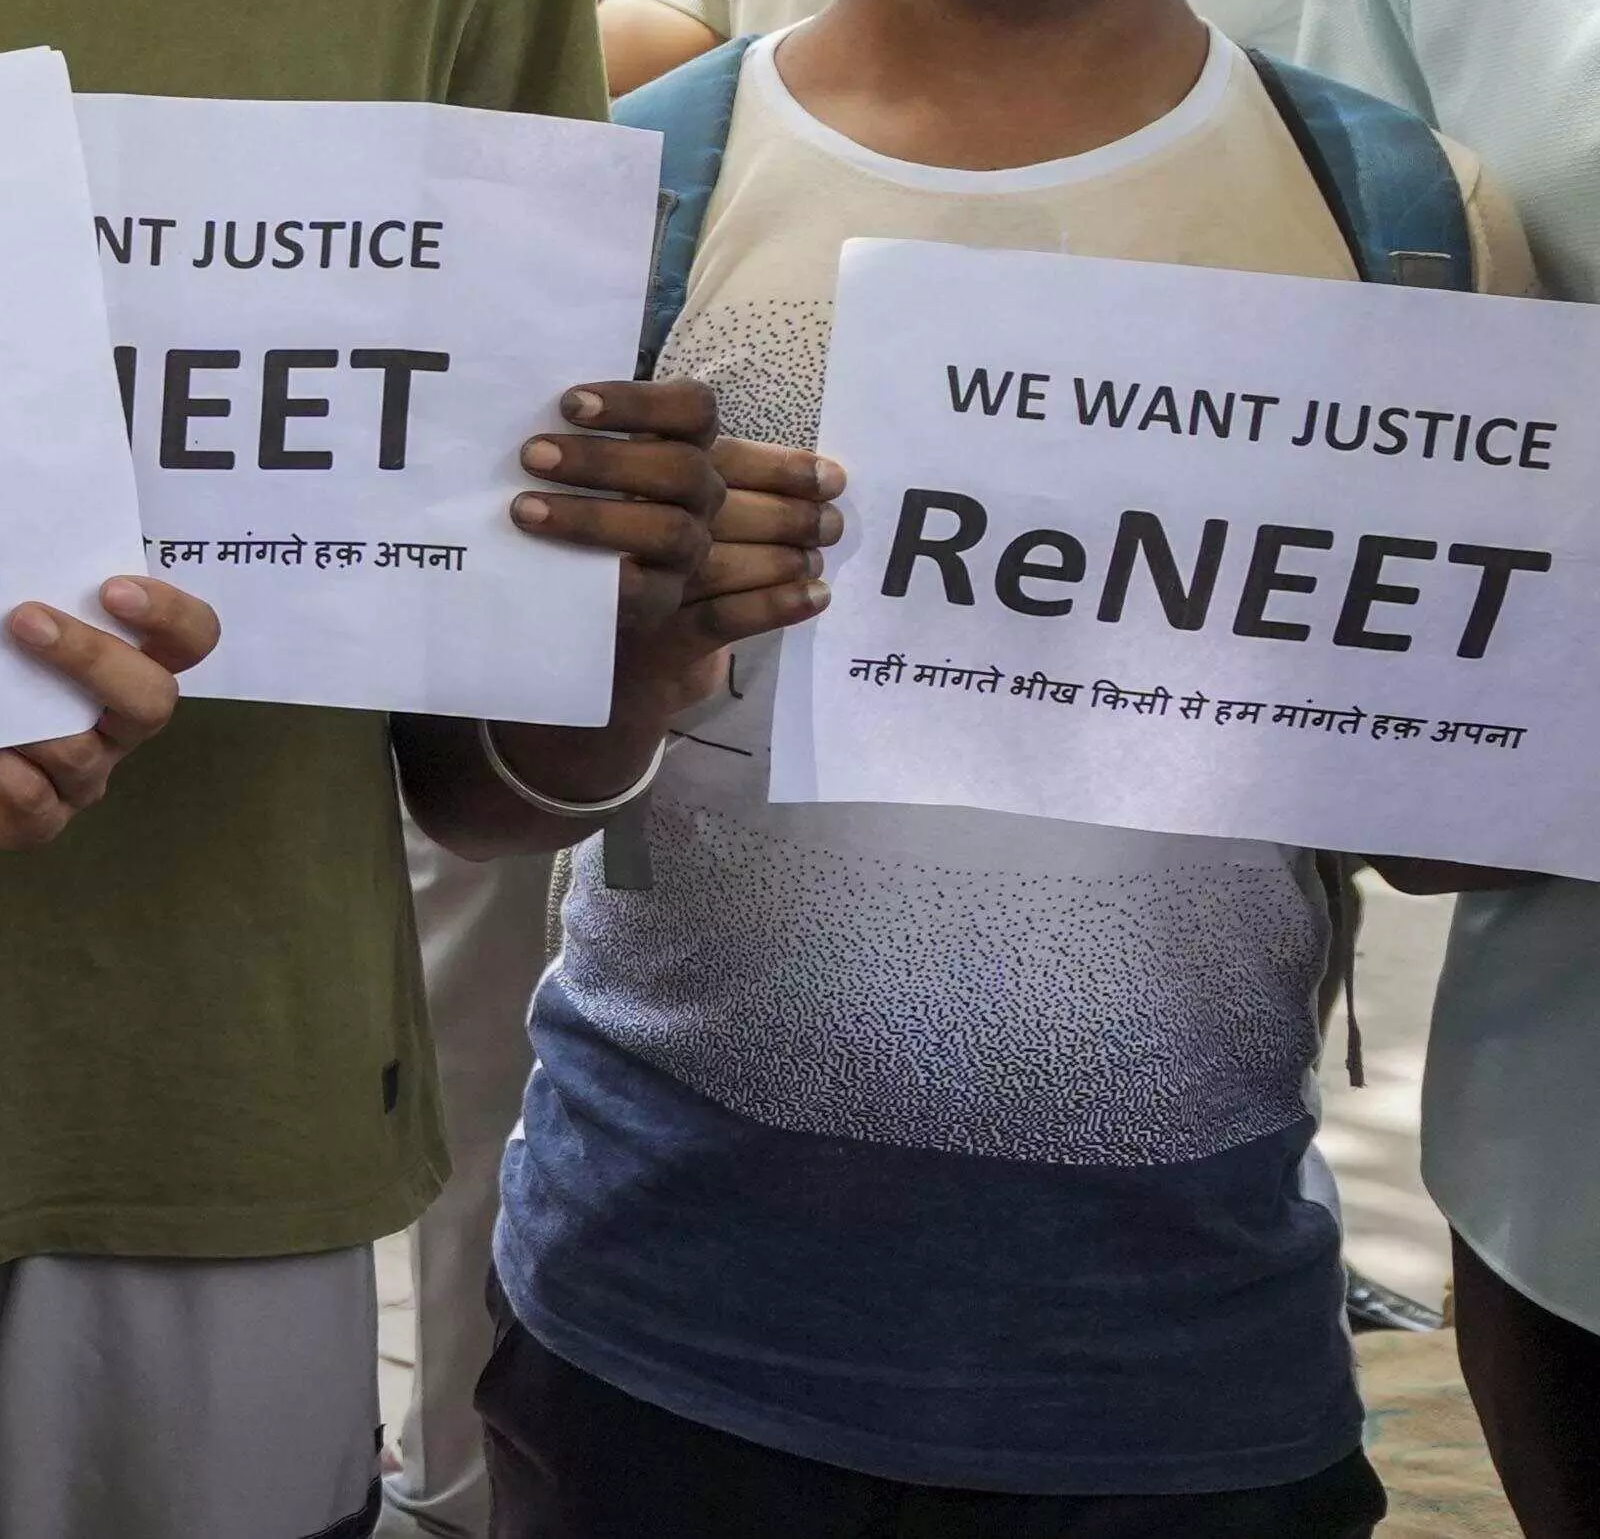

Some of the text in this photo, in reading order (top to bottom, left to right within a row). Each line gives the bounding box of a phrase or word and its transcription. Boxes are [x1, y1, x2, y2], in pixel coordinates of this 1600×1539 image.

[96, 215, 443, 269] NT JUSTICE
[113, 346, 450, 471] EET
[946, 364, 1557, 470] WE WANT JUSTICE
[159, 540, 209, 568] हम
[216, 533, 307, 565] मांगते
[373, 541, 467, 571] अपना
[880, 487, 1553, 660] ReNEET
[848, 653, 907, 686] नहीं
[912, 658, 1005, 693] मांगते
[1009, 670, 1084, 704] भीख
[1091, 679, 1173, 715] किसी
[1179, 690, 1210, 719] से
[1214, 699, 1267, 725] हम
[1271, 698, 1367, 734] मांगते
[1429, 720, 1527, 748] अपना
